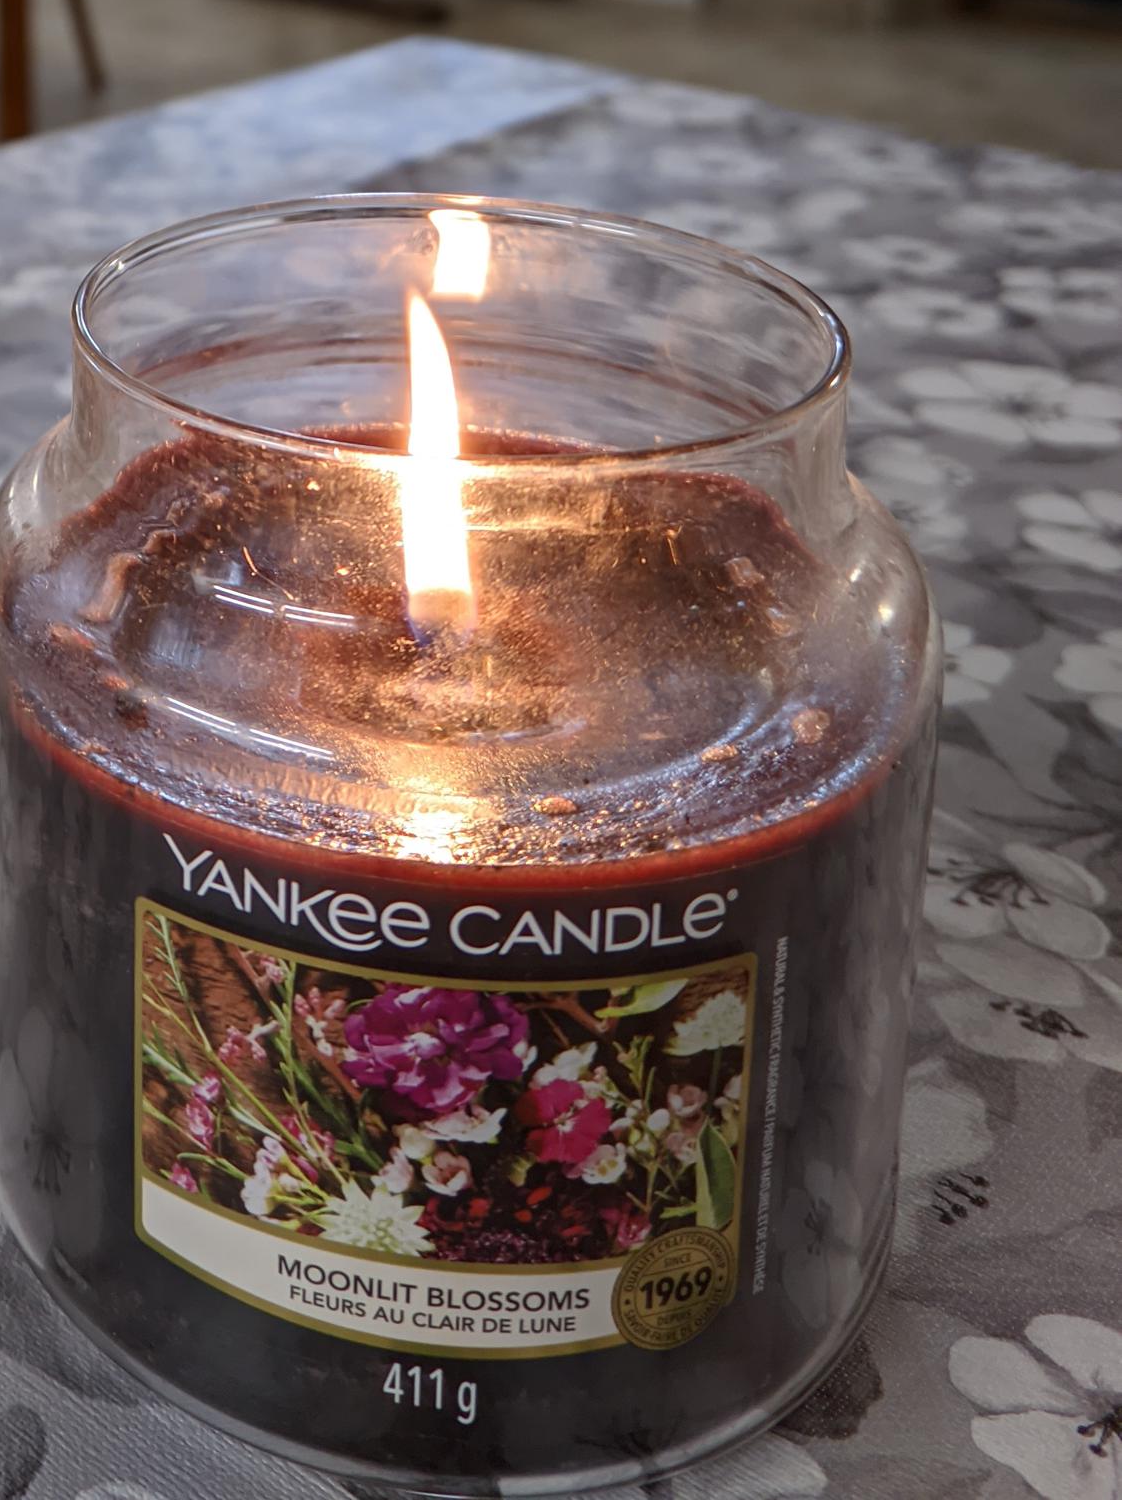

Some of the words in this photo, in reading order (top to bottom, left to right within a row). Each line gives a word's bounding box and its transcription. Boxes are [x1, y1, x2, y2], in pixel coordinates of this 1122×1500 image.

[773, 936, 789, 987] NATURAL
[769, 997, 784, 1054] SYNTHETIC
[765, 1055, 780, 1116] FRAGRANCE
[278, 1254, 417, 1304] MOONLIT
[428, 1287, 590, 1312] BLOSSOMS
[289, 1284, 367, 1318] FLEURS
[373, 1306, 405, 1325] AU
[412, 1312, 475, 1333] CLAIR
[482, 1317, 512, 1333] DE
[519, 1316, 577, 1334] LUNE
[640, 1266, 712, 1309] 1969
[382, 1362, 444, 1410] 411
[457, 1380, 479, 1425] g
